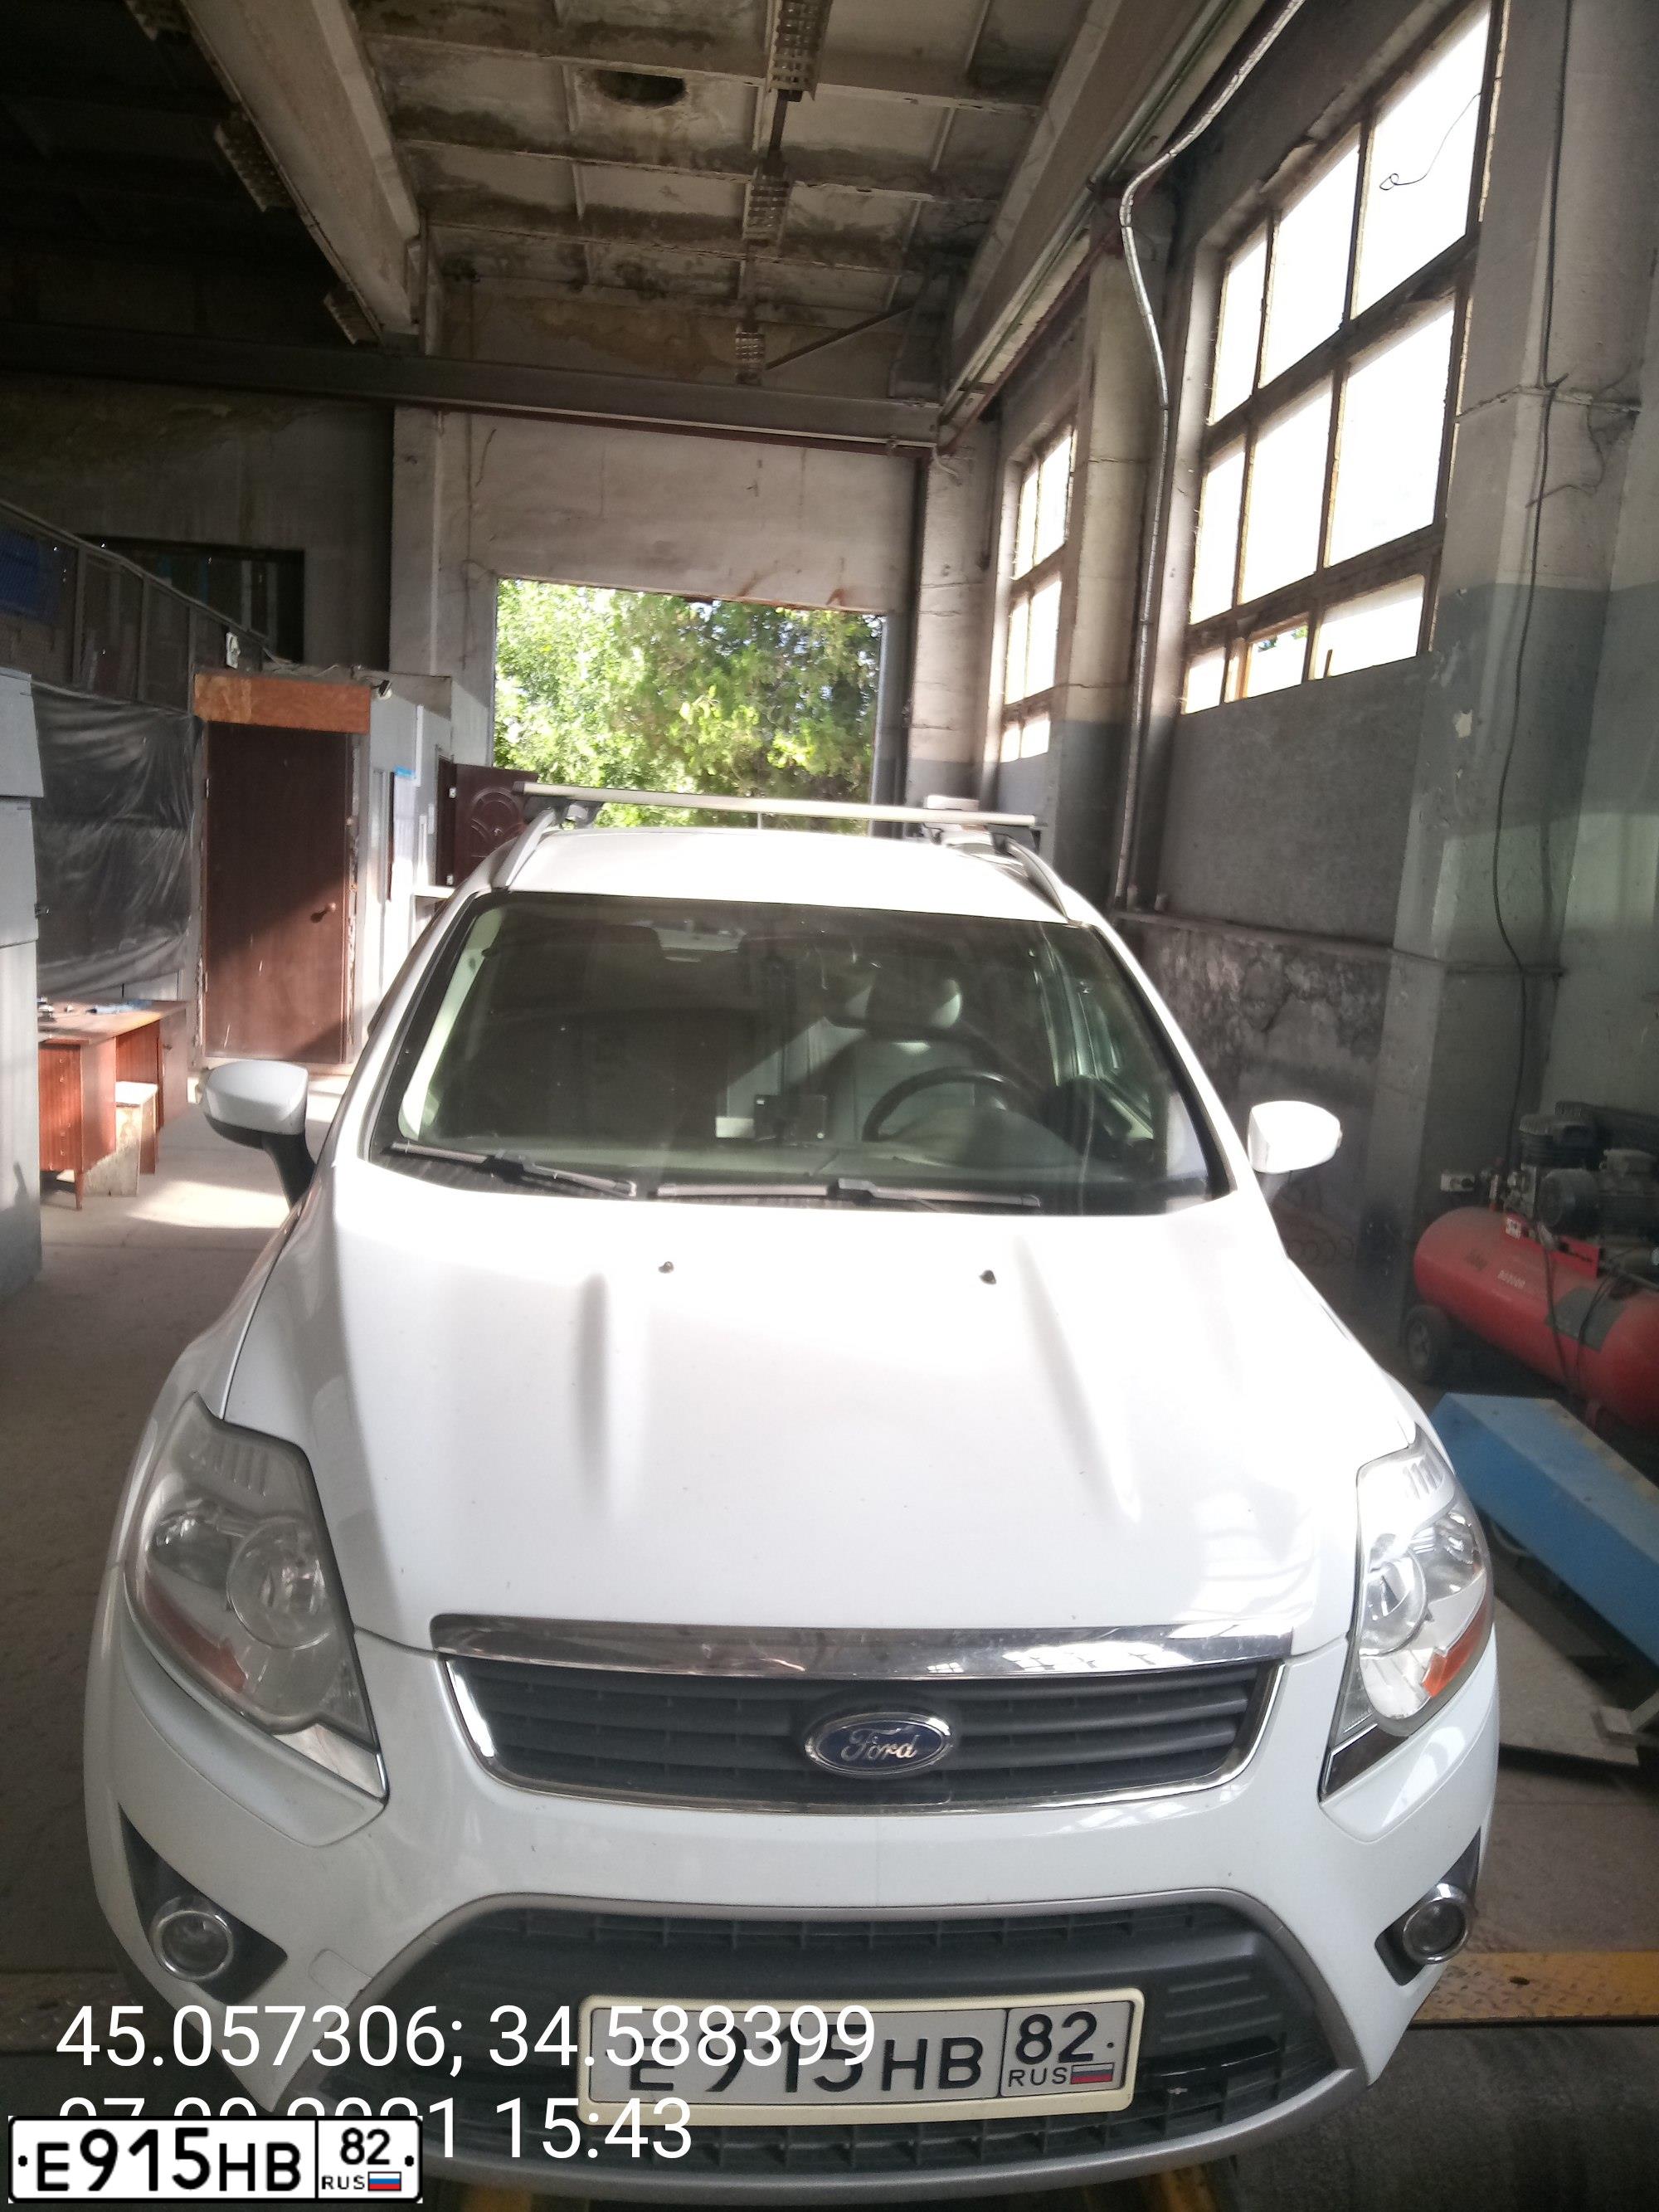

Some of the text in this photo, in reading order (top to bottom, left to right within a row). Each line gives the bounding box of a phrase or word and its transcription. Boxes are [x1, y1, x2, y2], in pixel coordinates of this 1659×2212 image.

[840, 1725, 922, 1762] Ford
[1015, 2010, 1097, 2066] 82
[1008, 2066, 1068, 2088] RUS
